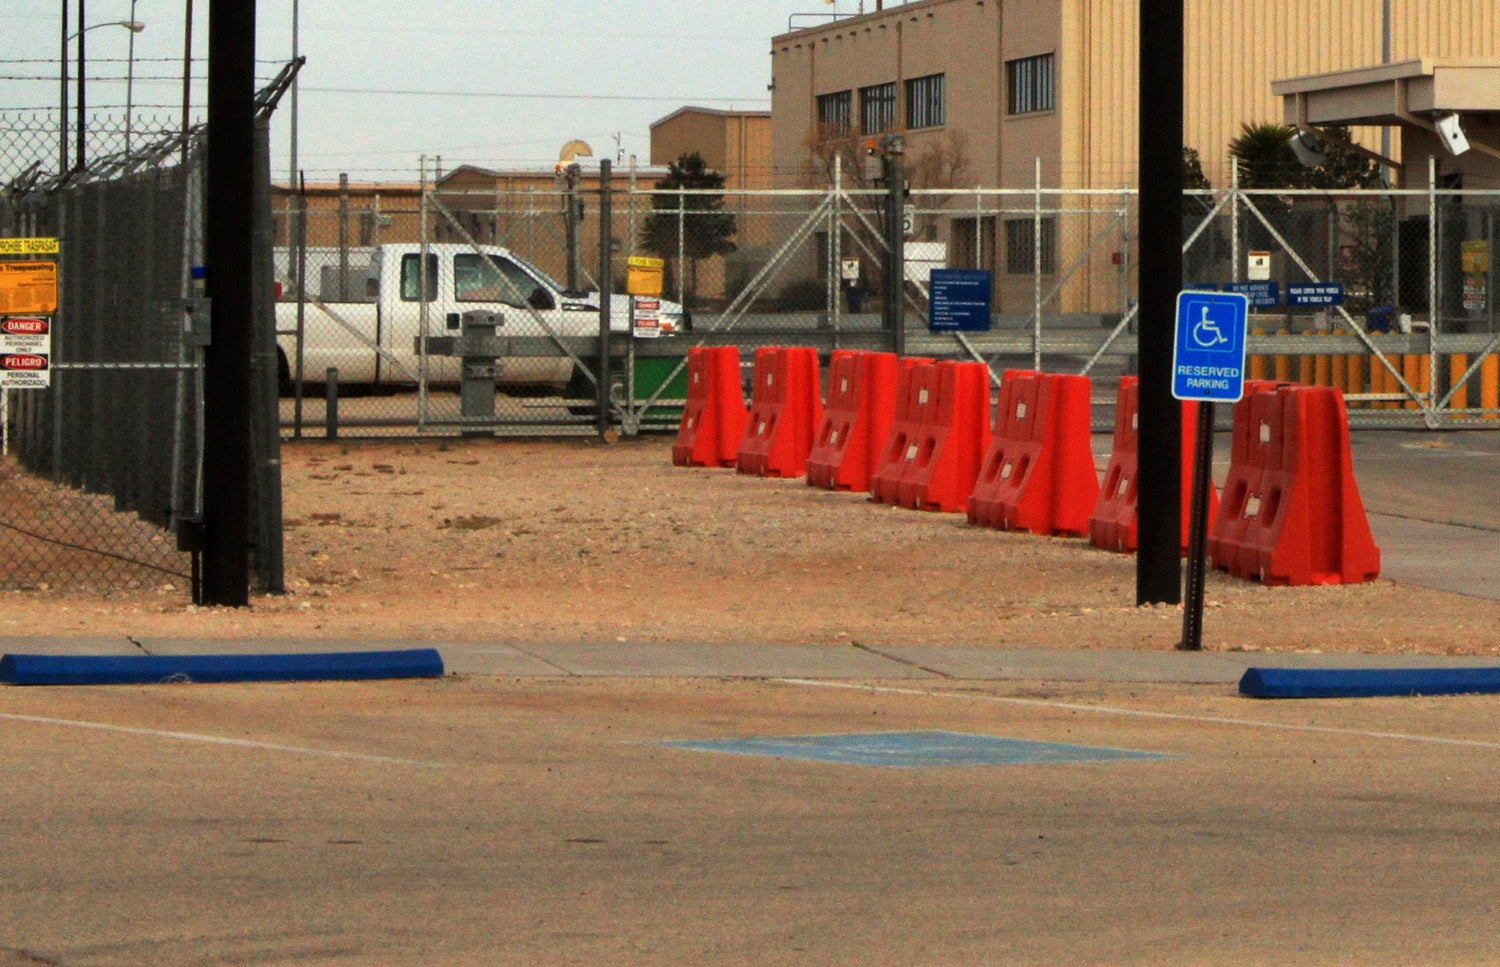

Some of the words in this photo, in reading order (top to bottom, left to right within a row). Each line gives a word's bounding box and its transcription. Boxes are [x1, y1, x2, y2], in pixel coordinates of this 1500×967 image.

[8, 322, 42, 331] DANGER
[5, 357, 42, 367] PELIGRO
[1178, 365, 1239, 378] RESERVED
[1186, 378, 1229, 389] PARKING
